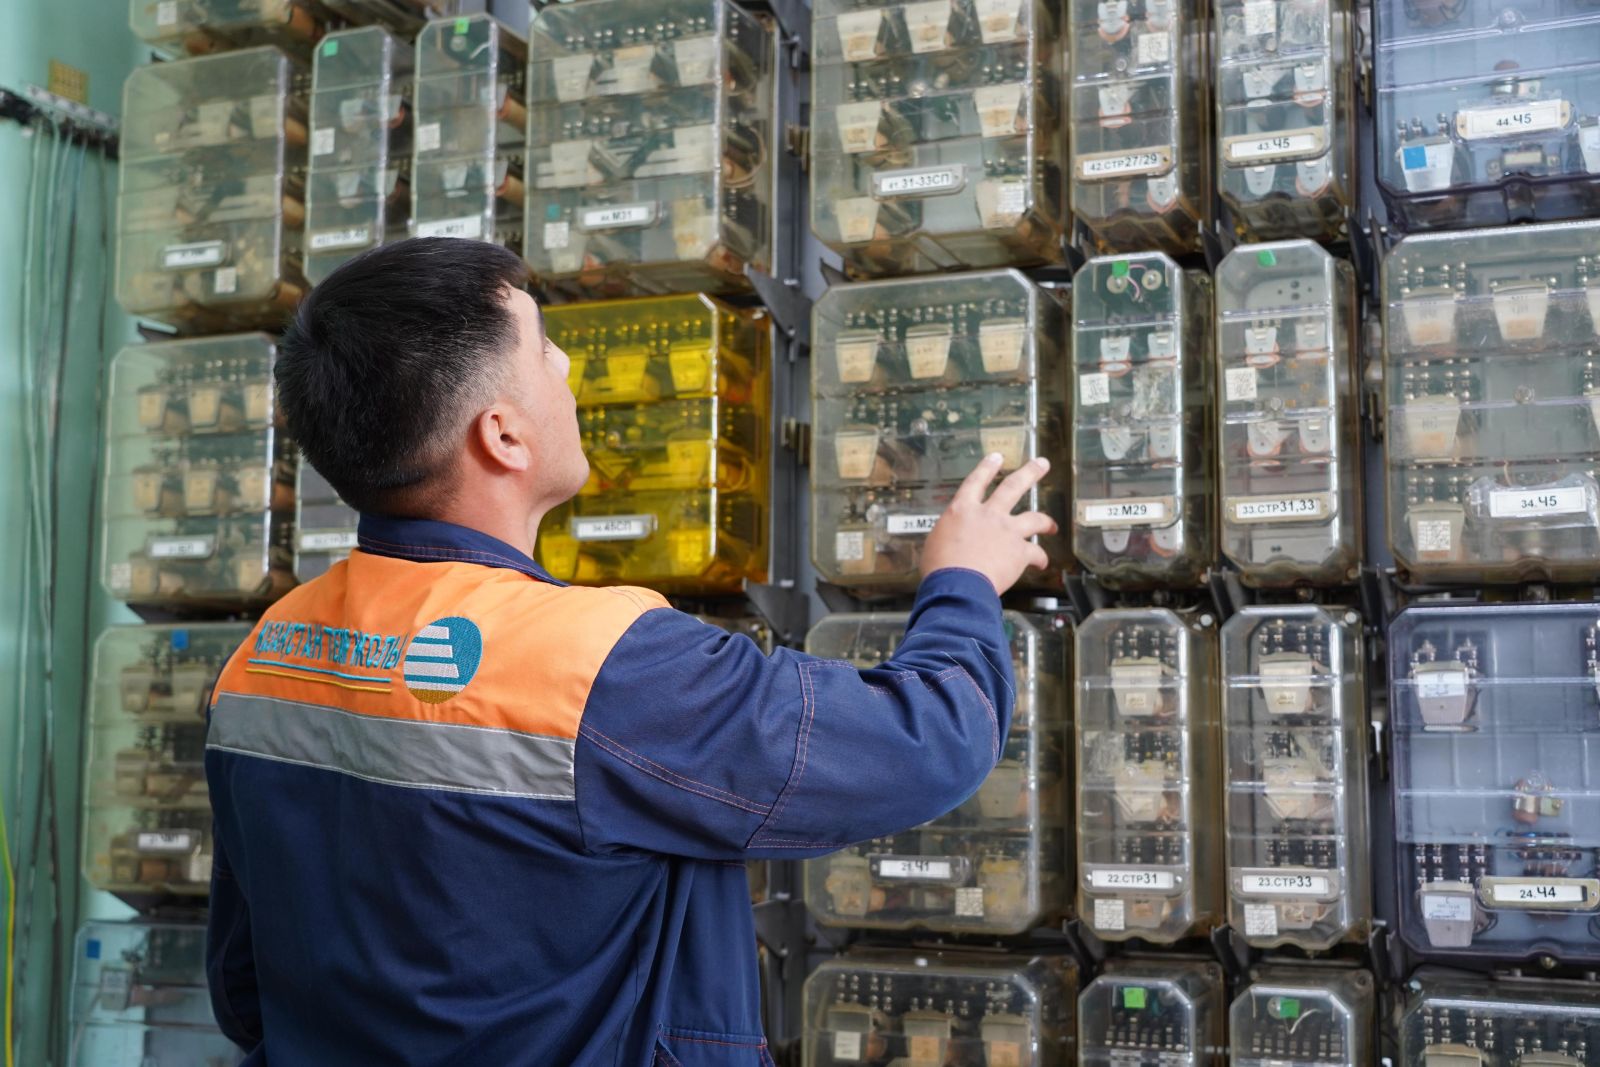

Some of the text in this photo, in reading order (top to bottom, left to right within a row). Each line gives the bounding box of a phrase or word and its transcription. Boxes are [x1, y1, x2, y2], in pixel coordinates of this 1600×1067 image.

[1496, 113, 1532, 126] 44.Ч5
[1090, 153, 1157, 171] 42.СТР27/29
[1242, 499, 1315, 514] 33.СТР31,33
[1521, 496, 1557, 508] 34.Ч5
[1107, 505, 1147, 516] 32.М29
[904, 518, 937, 529] 31.М2
[1107, 873, 1157, 884] 22.СТР31
[1258, 875, 1312, 887] 23.СТР33
[1520, 886, 1556, 899] 24.Ч4
